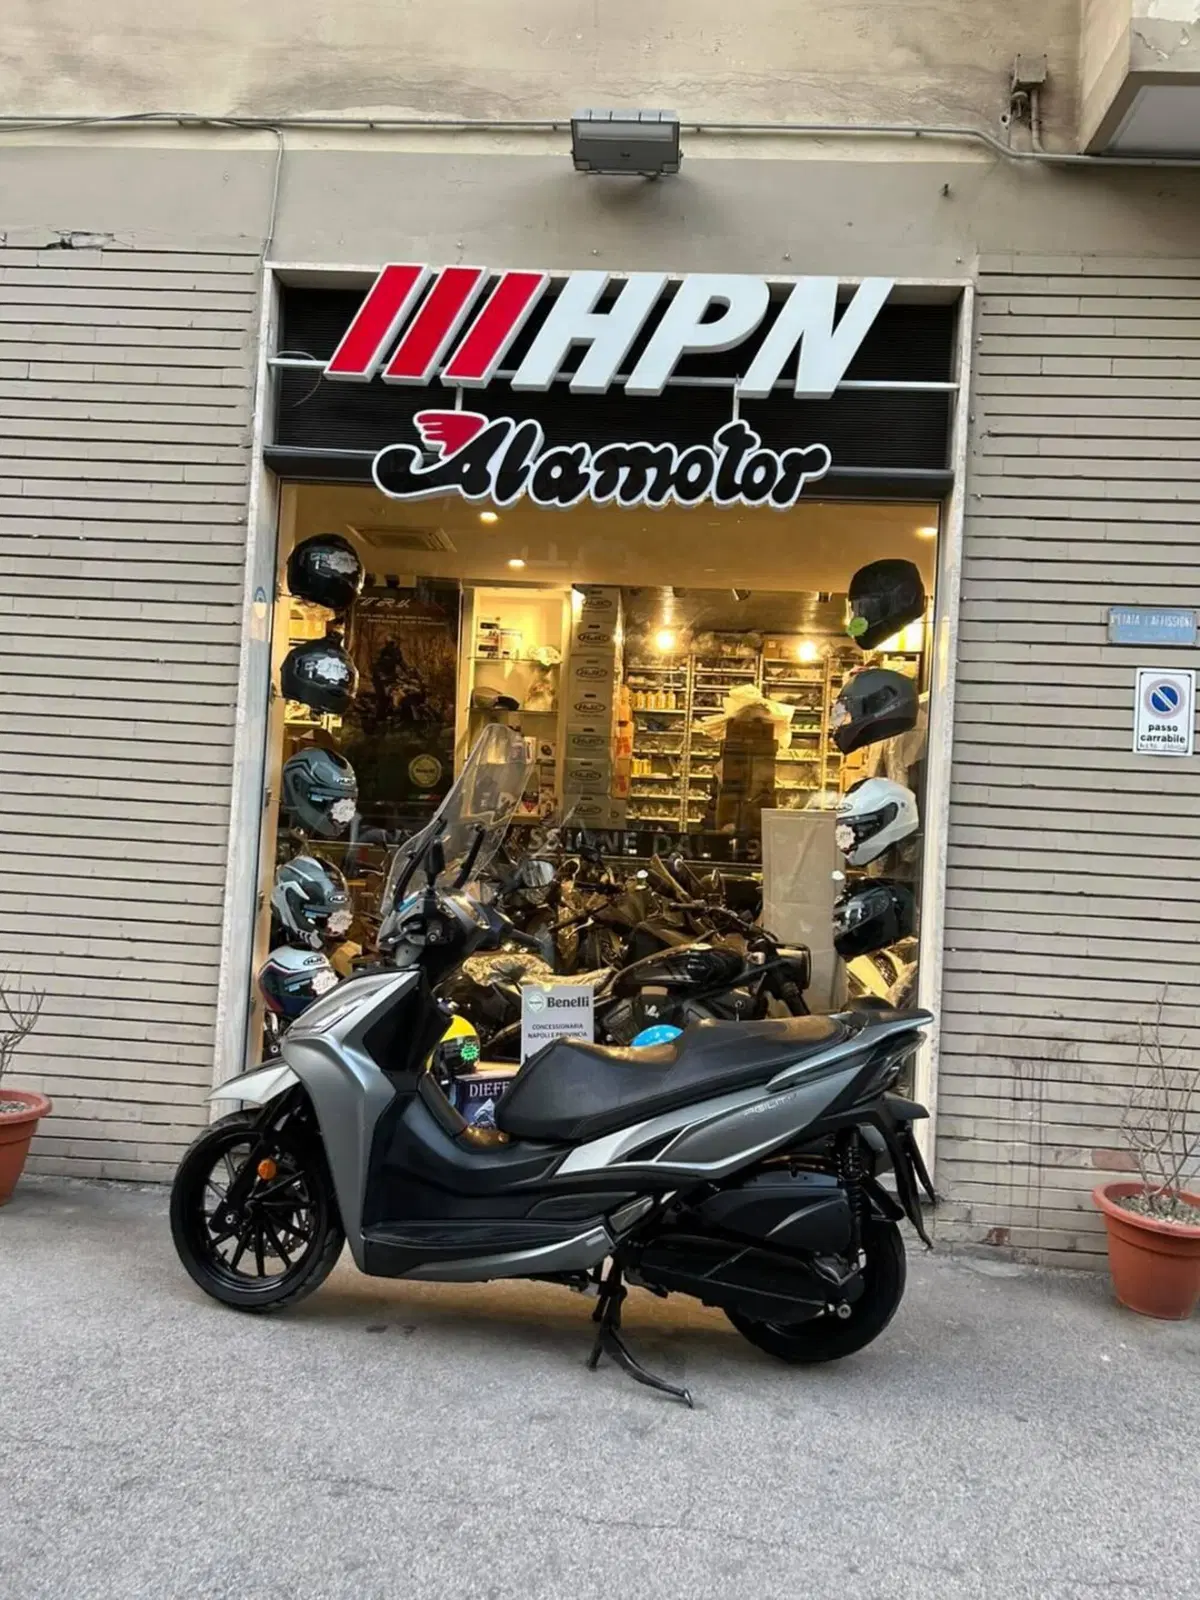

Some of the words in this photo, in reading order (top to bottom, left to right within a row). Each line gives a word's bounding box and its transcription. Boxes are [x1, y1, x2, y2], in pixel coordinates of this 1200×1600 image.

[511, 271, 896, 399] HPN
[372, 412, 832, 510] Alamotor
[1148, 723, 1179, 733] passo
[1140, 734, 1186, 744] carrabile
[547, 996, 590, 1008] Benelli
[532, 1023, 583, 1031] CONCESSIONARIA
